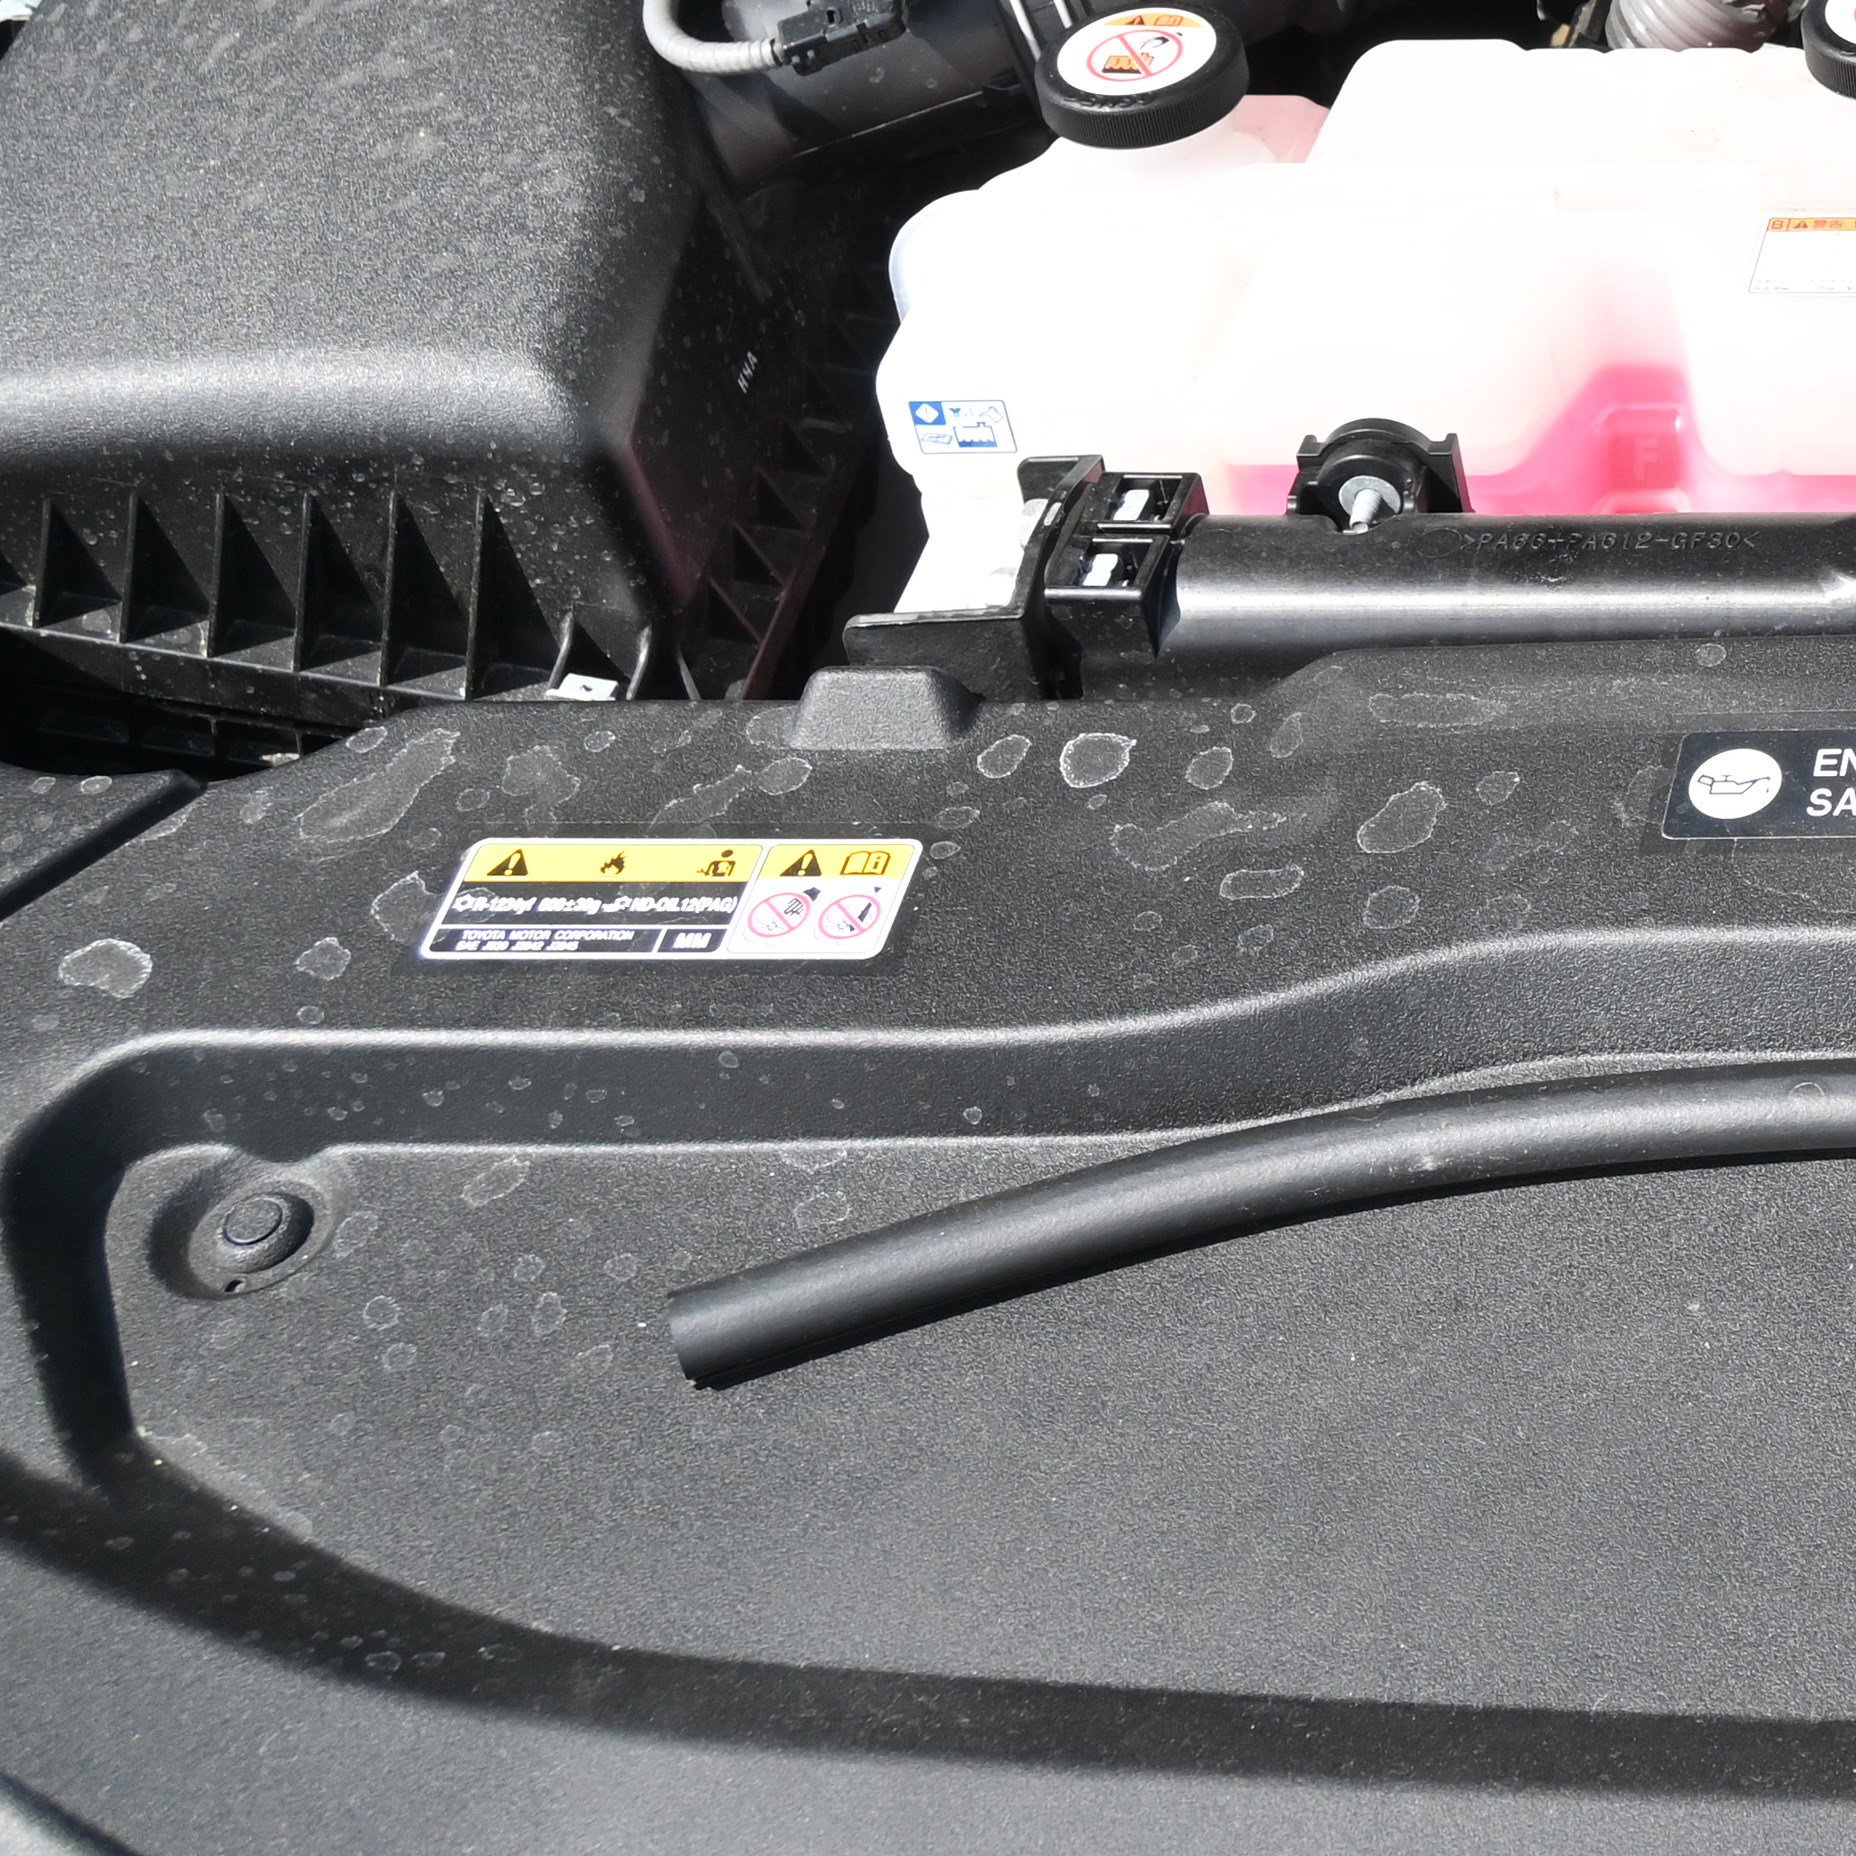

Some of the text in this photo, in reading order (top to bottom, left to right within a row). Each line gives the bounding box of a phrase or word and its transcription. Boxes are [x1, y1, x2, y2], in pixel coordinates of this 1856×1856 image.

[1770, 219, 1785, 230] B
[462, 929, 636, 941] TOYOTA MOTOR CORPORATION
[672, 932, 712, 949] MM
